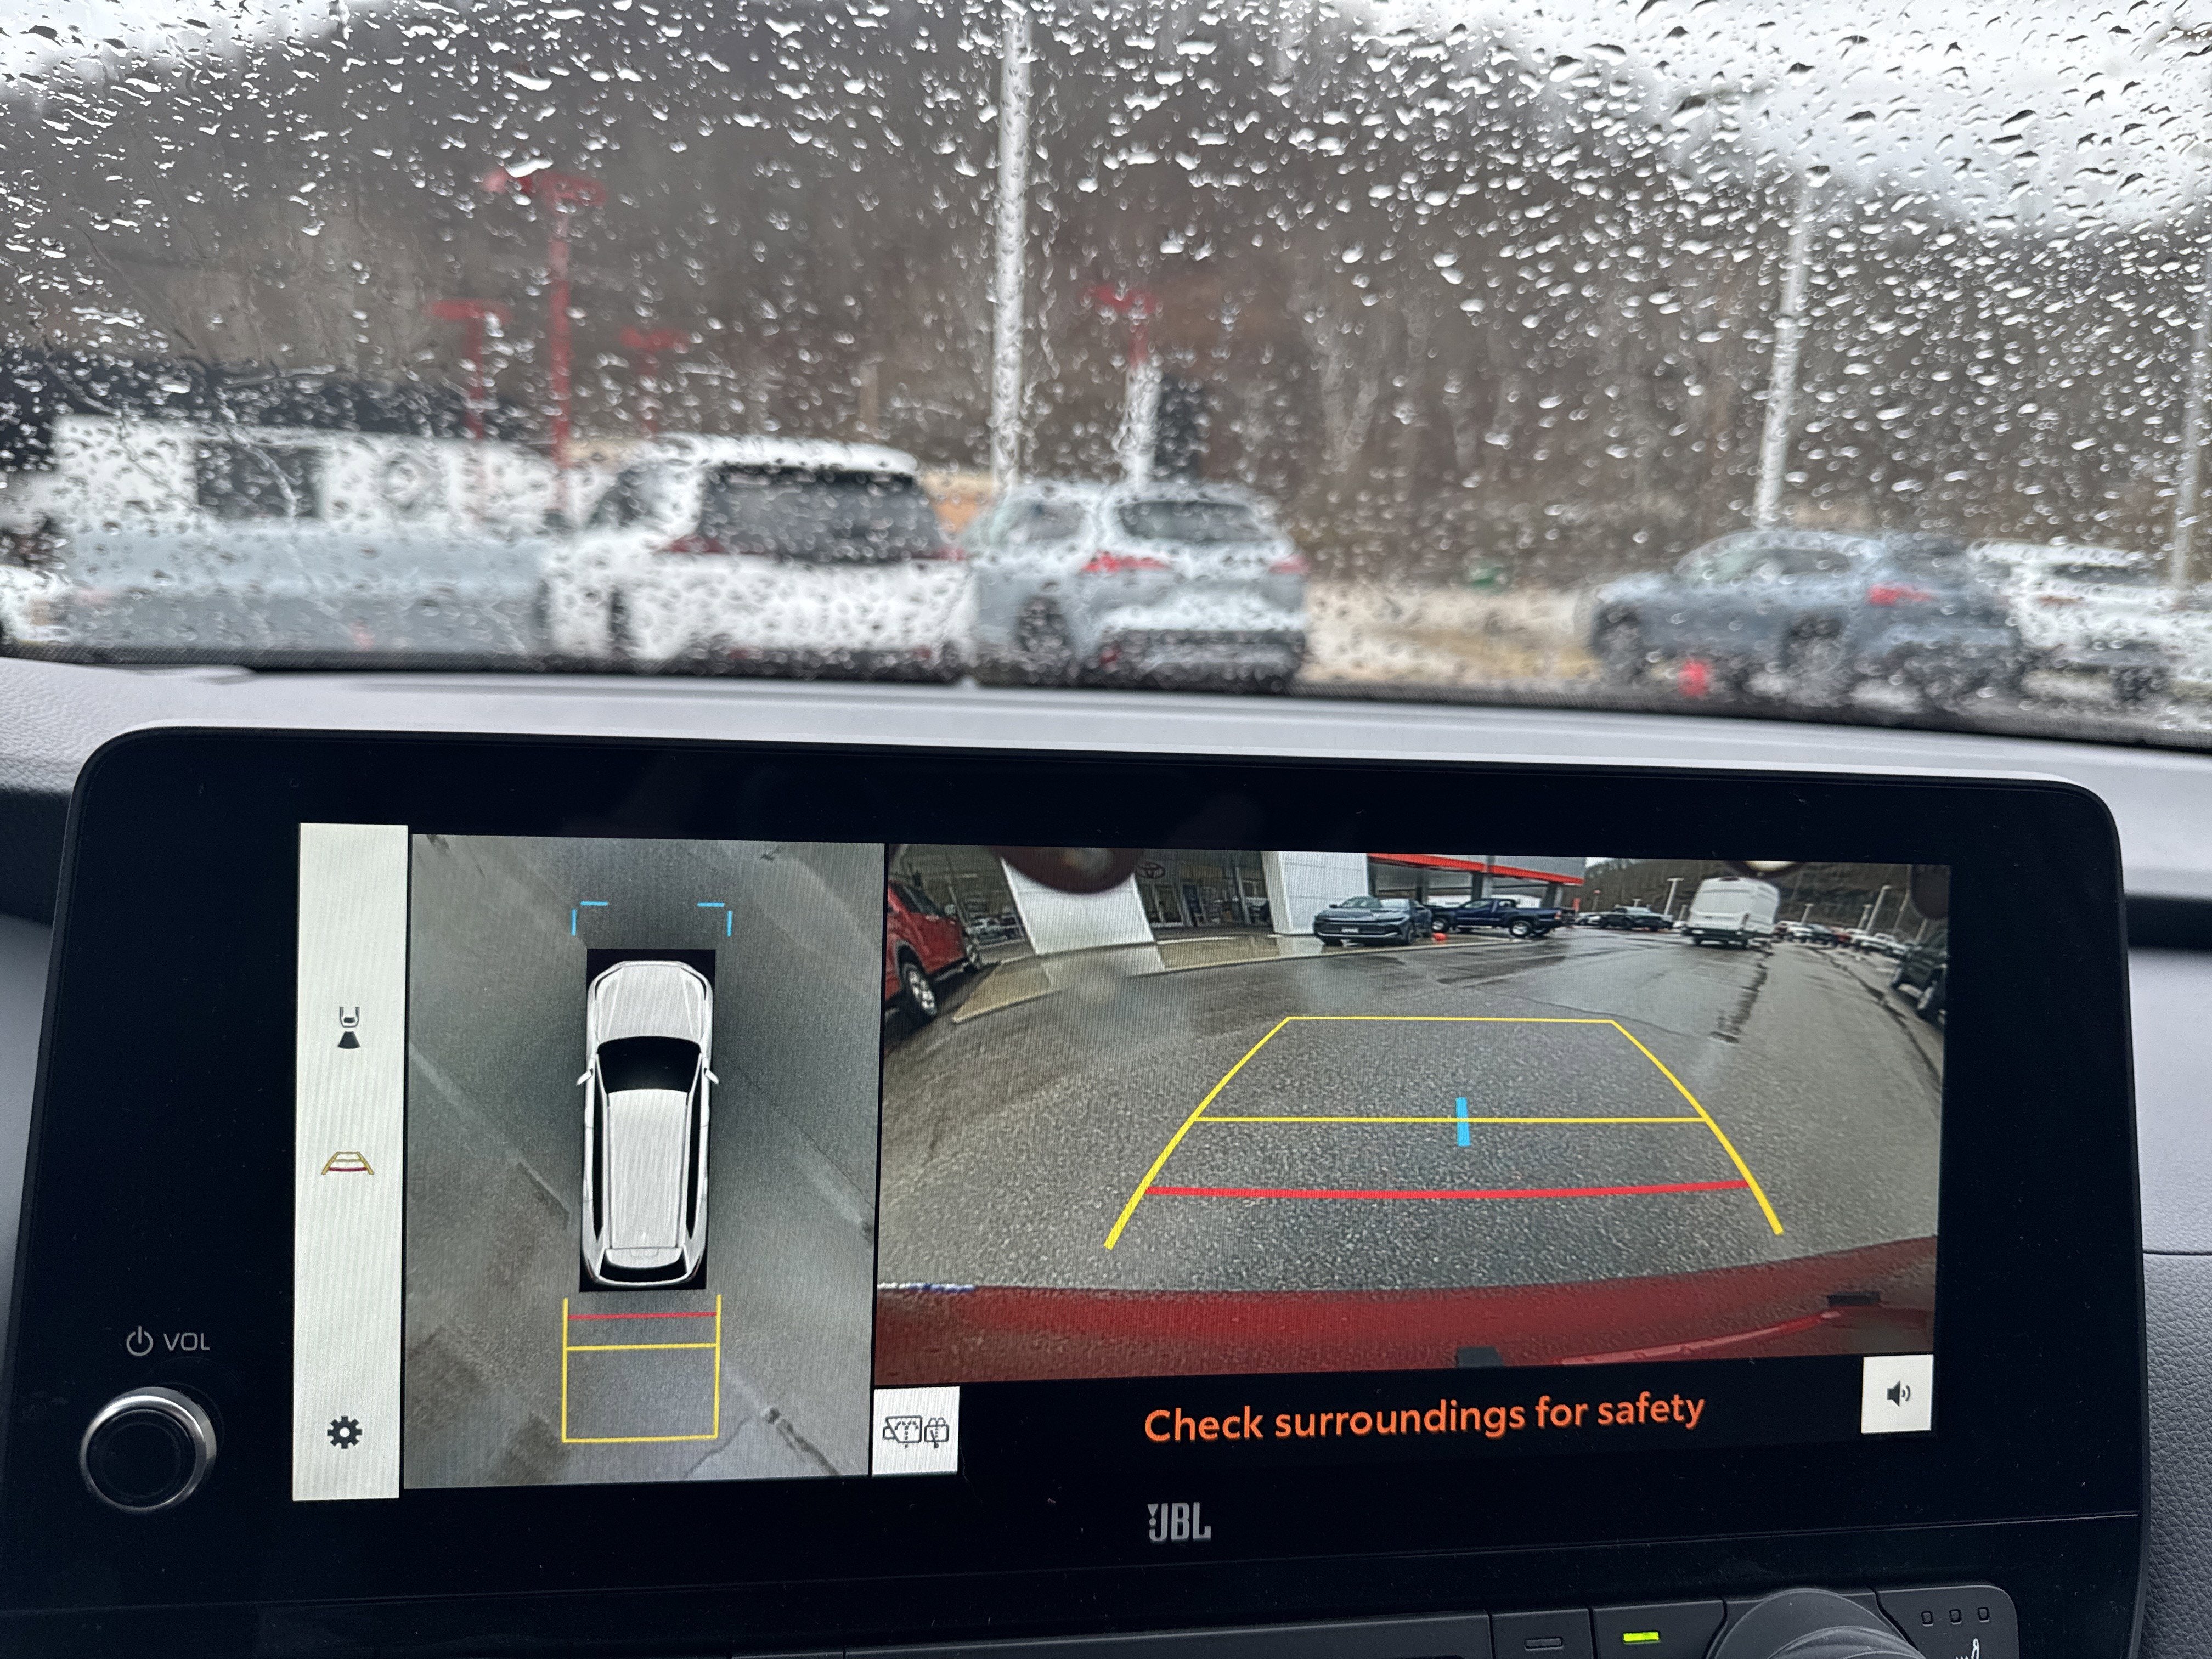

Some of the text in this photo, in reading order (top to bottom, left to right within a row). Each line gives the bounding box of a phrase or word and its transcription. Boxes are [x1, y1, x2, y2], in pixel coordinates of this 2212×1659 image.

[163, 1332, 211, 1351] VOL
[1144, 1391, 1705, 1442] Check surroundings for safety
[1147, 1502, 1212, 1542] JBL
